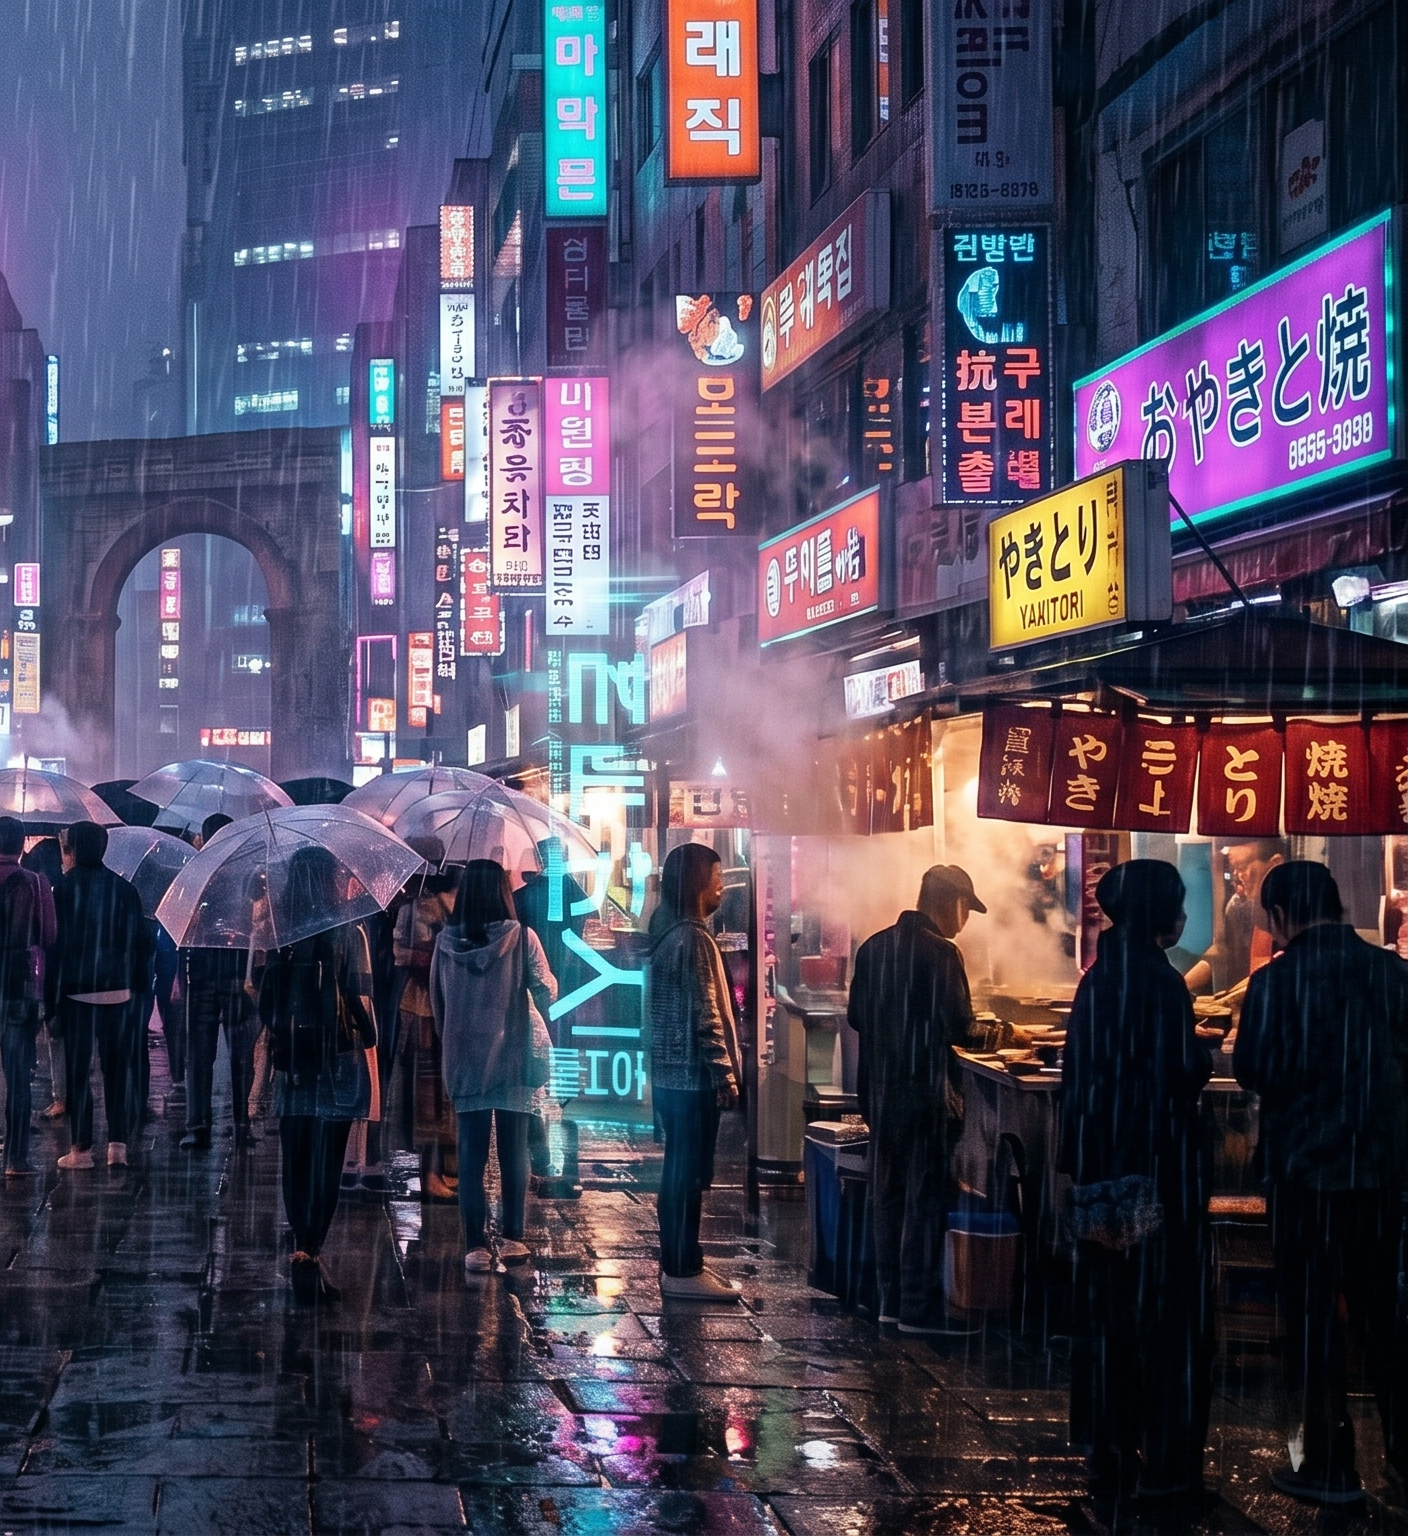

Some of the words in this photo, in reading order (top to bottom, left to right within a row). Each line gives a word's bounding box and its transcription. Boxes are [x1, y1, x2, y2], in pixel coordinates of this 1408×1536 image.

[999, 499, 1097, 599] やきとり
[1020, 590, 1083, 629] YAKITORI
[1066, 733, 1107, 811] やき
[1225, 745, 1259, 822] とり
